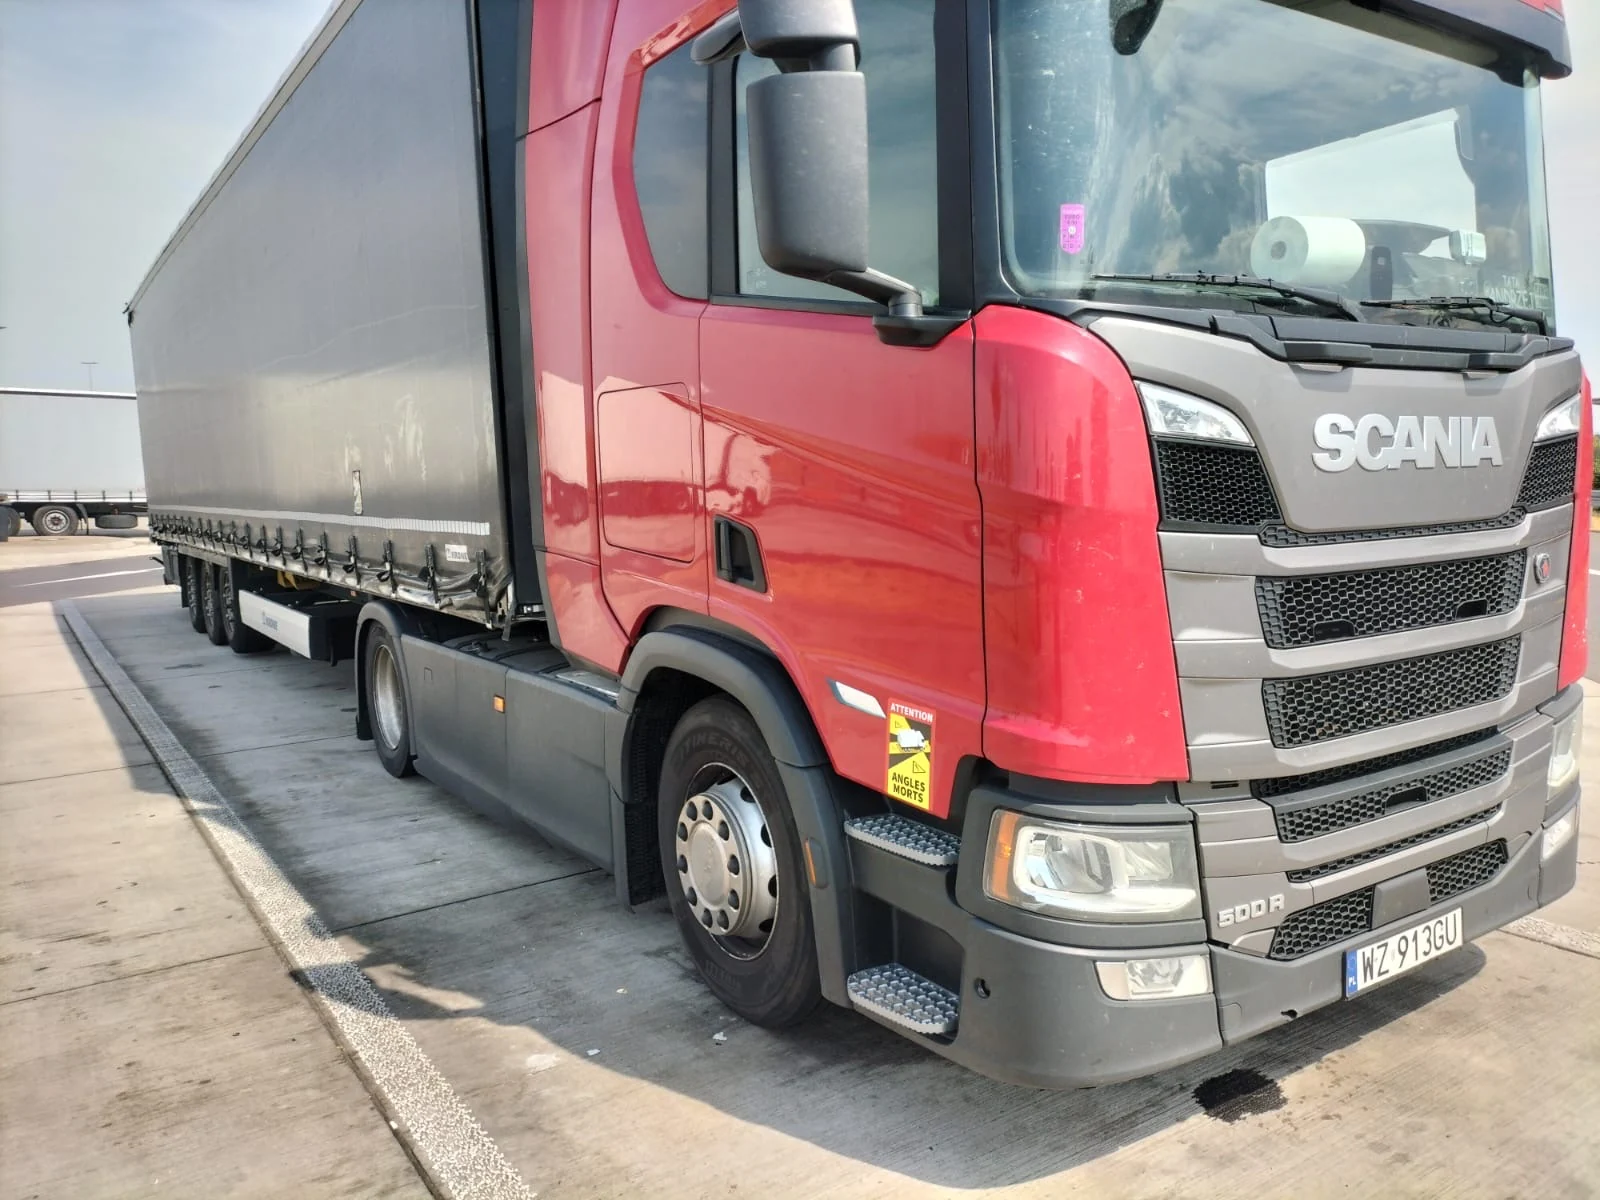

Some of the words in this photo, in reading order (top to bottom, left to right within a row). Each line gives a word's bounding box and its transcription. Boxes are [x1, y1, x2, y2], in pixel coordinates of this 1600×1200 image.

[1312, 413, 1503, 473] SCANIA
[890, 703, 933, 722] ATTENTION
[892, 772, 926, 792] ANGLES
[893, 783, 924, 803] MORTS
[1218, 899, 1266, 928] 500
[1268, 893, 1285, 913] R
[1362, 942, 1390, 983] WZ
[1397, 913, 1457, 968] 913GU
[1348, 976, 1356, 987] PL
